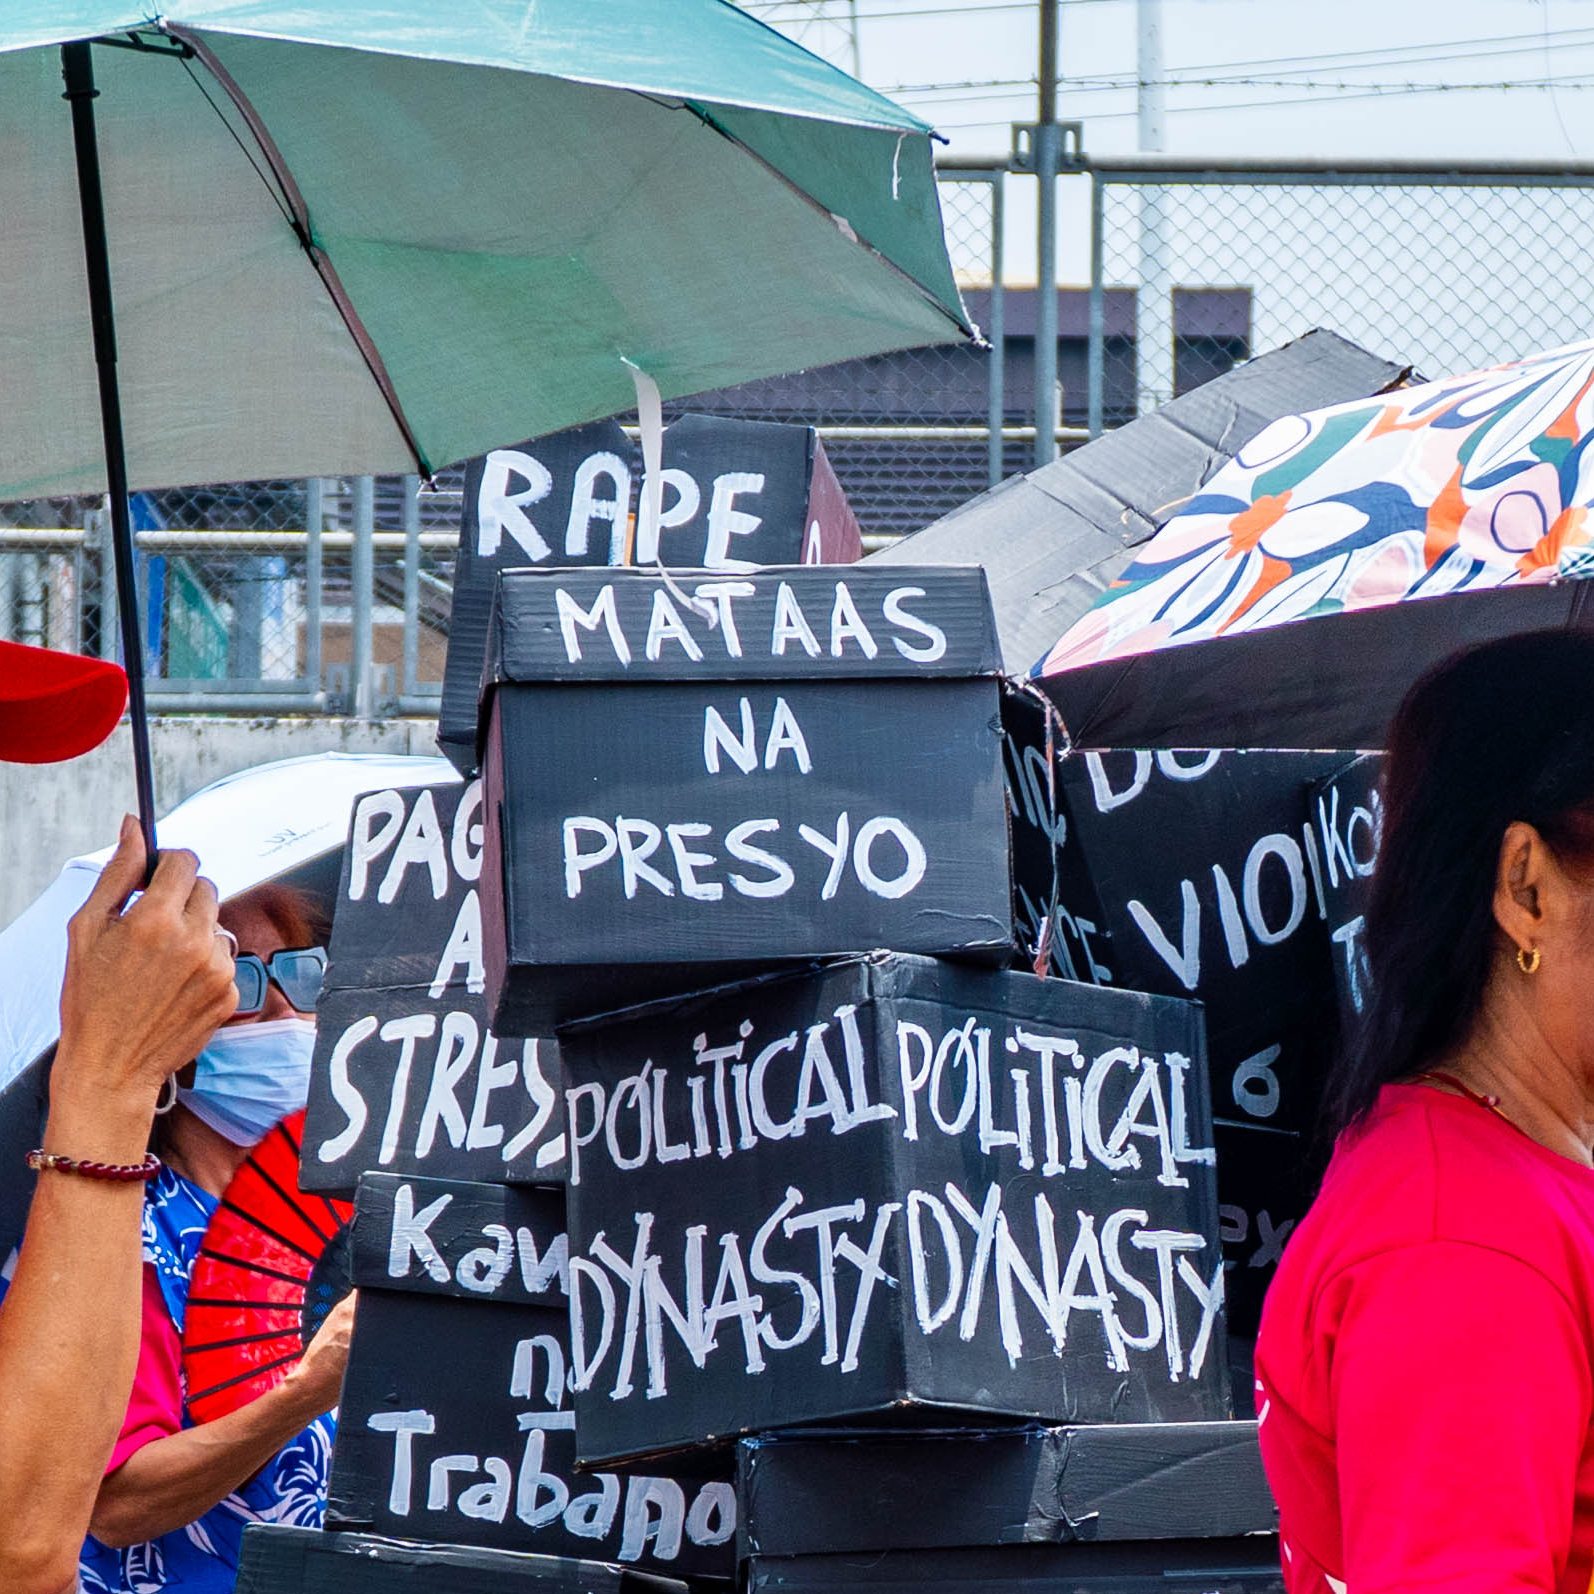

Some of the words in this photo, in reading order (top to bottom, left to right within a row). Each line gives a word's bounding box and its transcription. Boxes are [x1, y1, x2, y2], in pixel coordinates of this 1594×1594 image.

[478, 450, 765, 571] RAPE
[554, 582, 947, 668] MATAAS
[703, 696, 811, 775] NA
[562, 811, 927, 902] PRESYO
[566, 1004, 899, 1186] POLITICAL
[896, 1017, 1216, 1188] POLITICAL
[568, 1186, 903, 1401] DYNASTY
[907, 1183, 1226, 1382] DYNASTY
